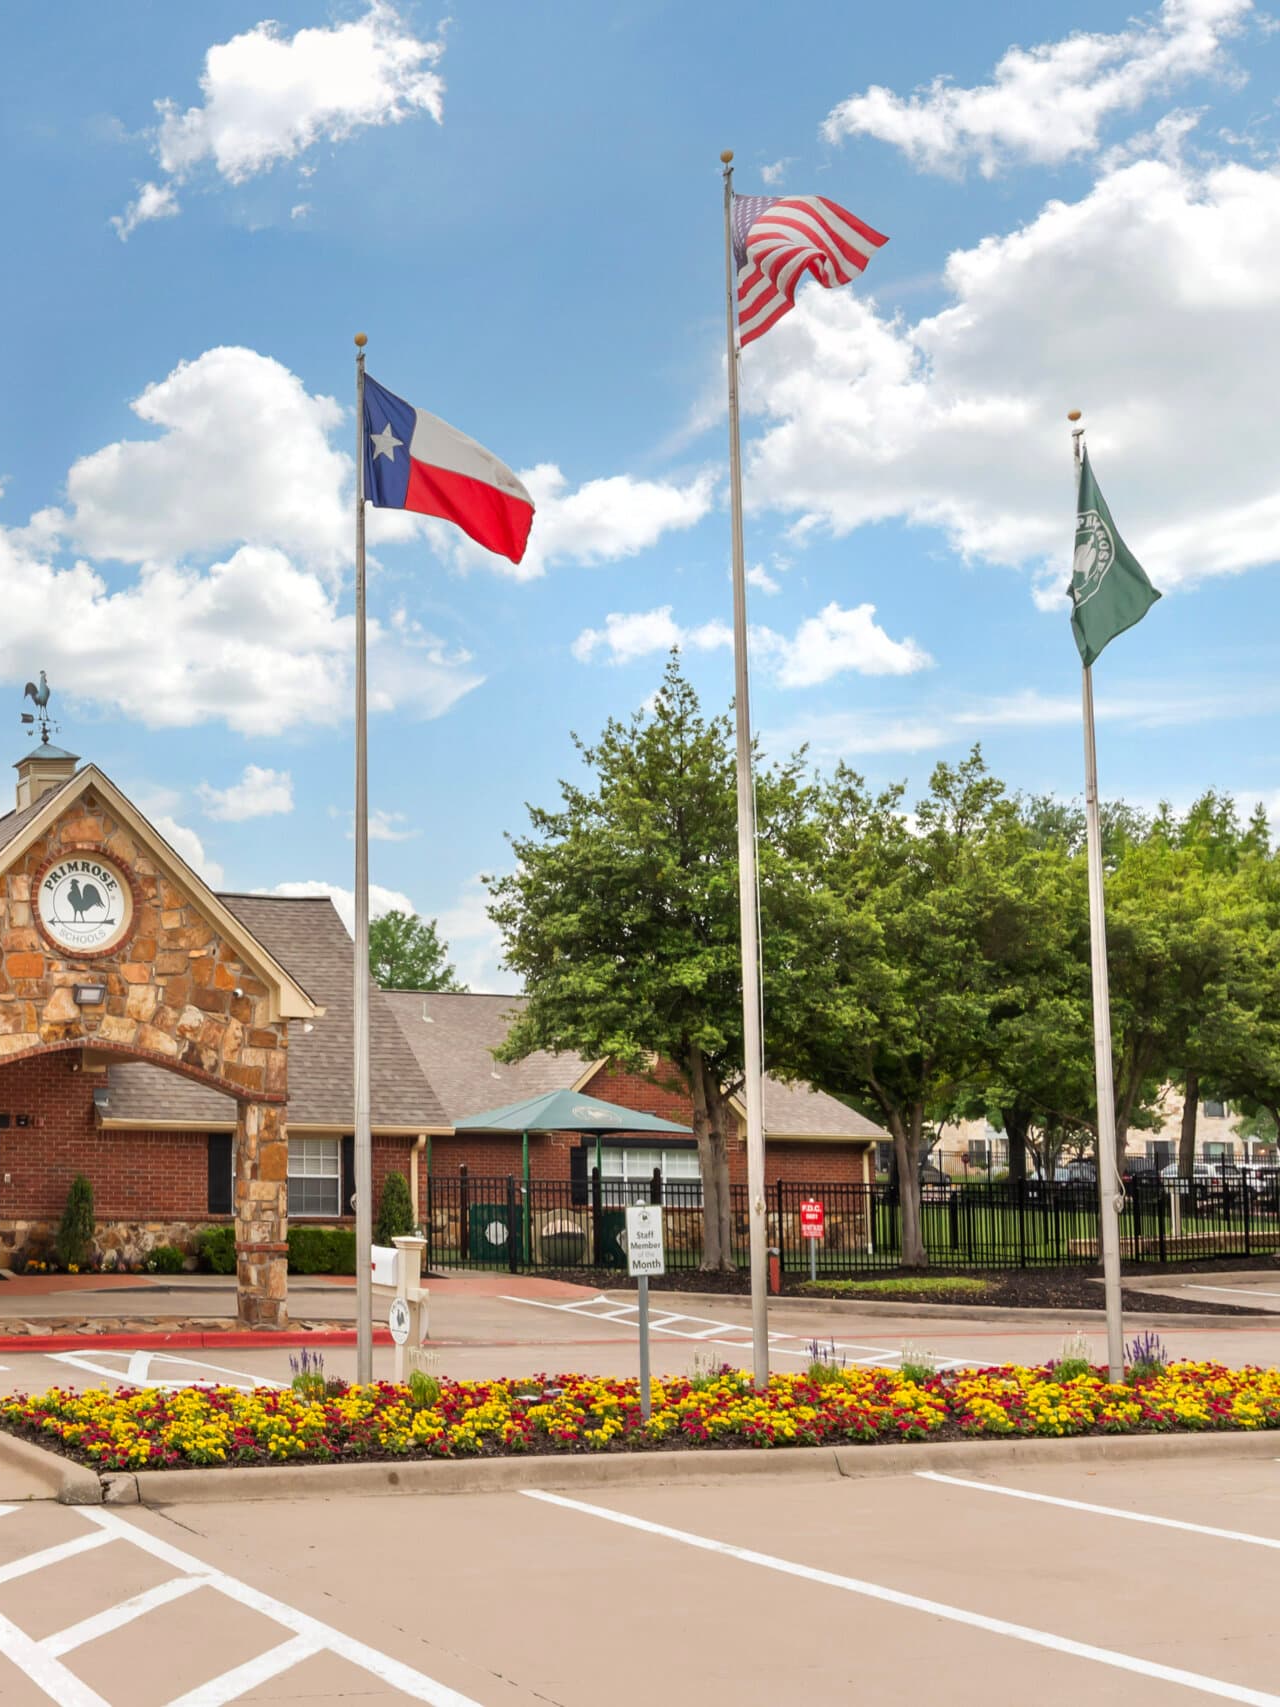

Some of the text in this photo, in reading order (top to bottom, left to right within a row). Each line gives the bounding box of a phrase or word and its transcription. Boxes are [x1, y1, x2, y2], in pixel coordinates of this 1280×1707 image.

[44, 861, 117, 891] PRIMROSE
[59, 929, 106, 943] SCHOOLS
[636, 1231, 654, 1239] Staff
[630, 1241, 661, 1249] Member
[632, 1259, 661, 1269] Month
